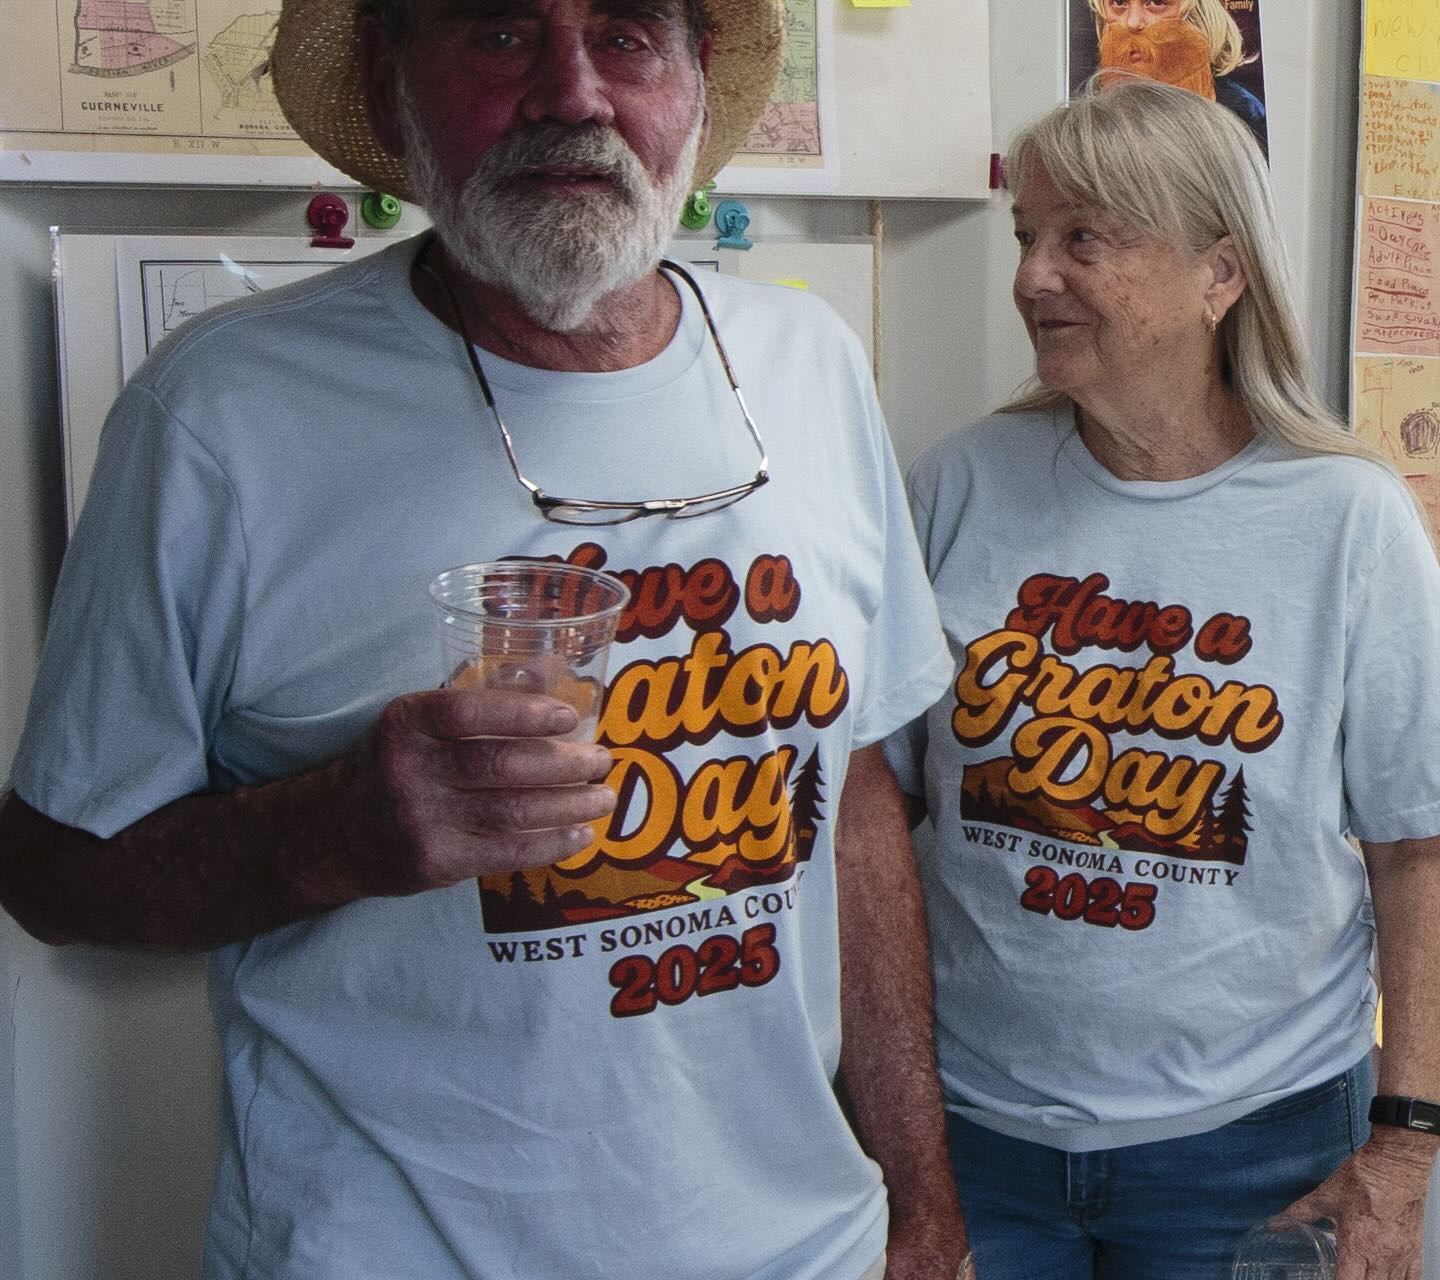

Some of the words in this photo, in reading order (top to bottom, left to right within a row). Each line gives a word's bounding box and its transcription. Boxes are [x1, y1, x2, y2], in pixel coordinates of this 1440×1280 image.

[80, 101, 165, 113] GUERNEVILLE
[746, 553, 802, 623] a
[1005, 572, 1195, 657] Have
[1194, 612, 1253, 665] a
[951, 628, 1285, 754] Graton
[550, 743, 800, 876] Day
[1007, 714, 1227, 842] Day
[962, 825, 1022, 854] WEST
[1028, 839, 1125, 875] SONOMA
[1134, 858, 1240, 887] COUNTY
[487, 934, 588, 963] WEST
[600, 904, 735, 953] SONOMA
[1020, 865, 1159, 932] 2025
[608, 922, 781, 1019] 2025
